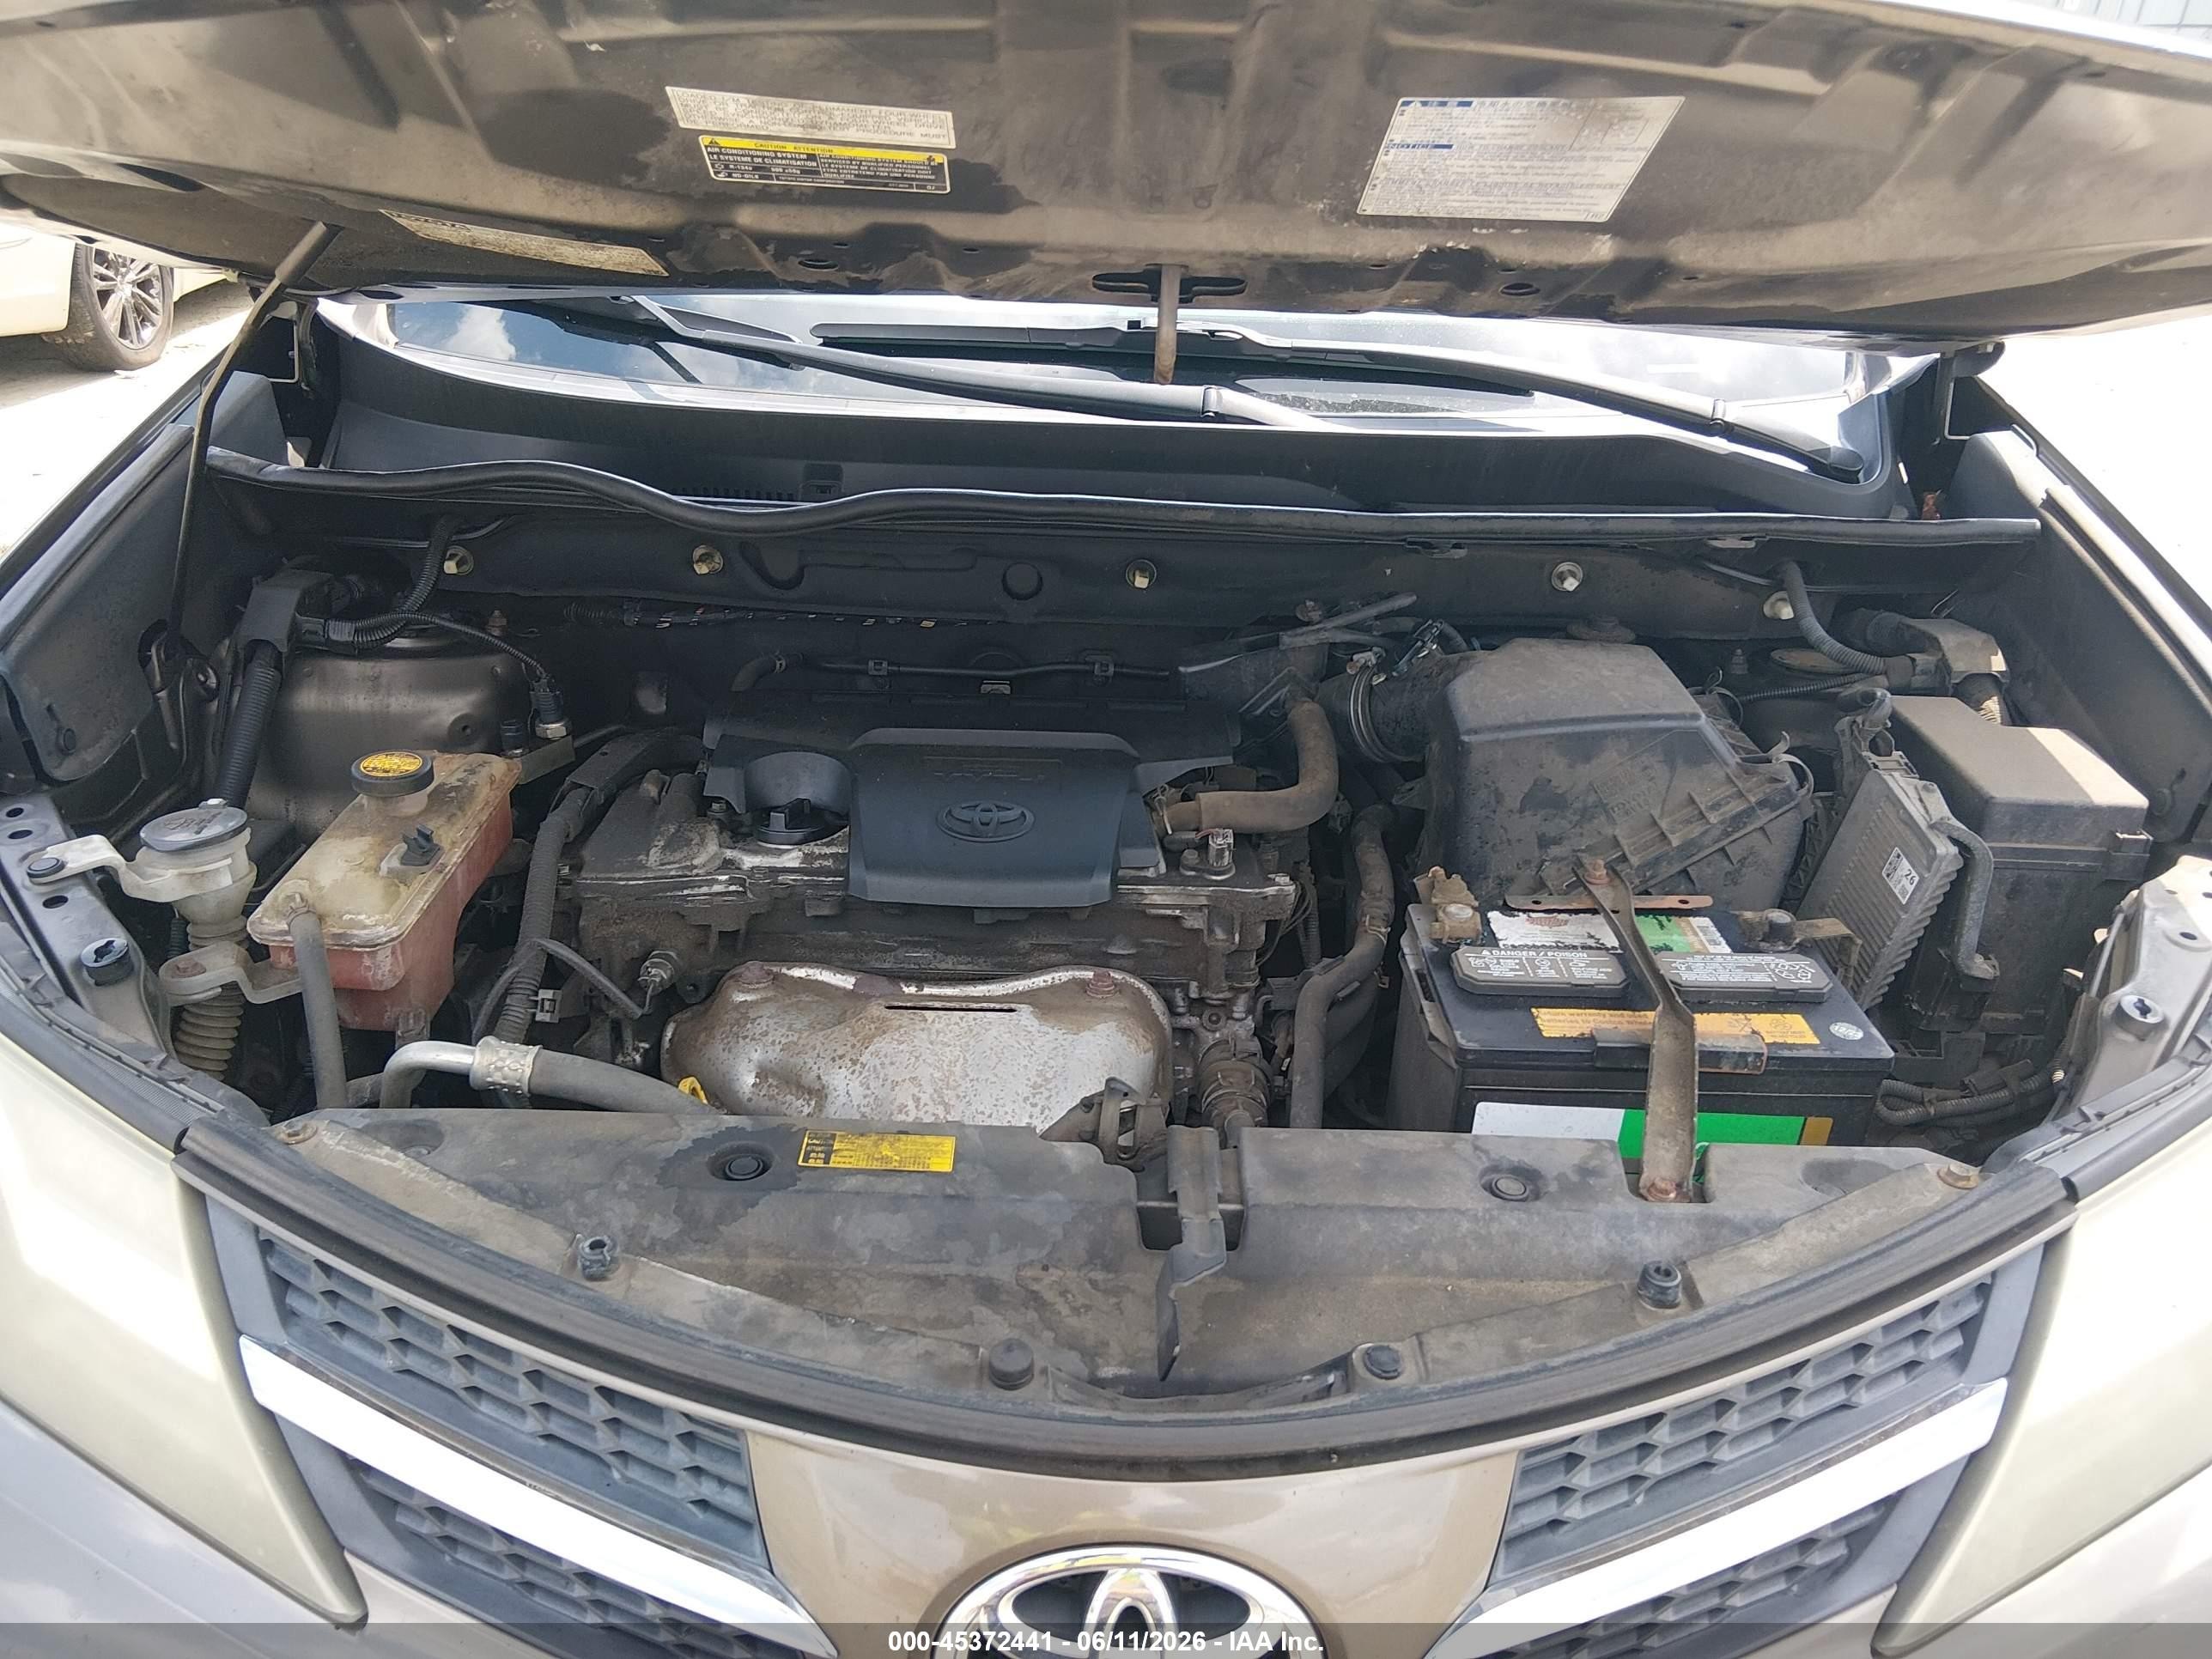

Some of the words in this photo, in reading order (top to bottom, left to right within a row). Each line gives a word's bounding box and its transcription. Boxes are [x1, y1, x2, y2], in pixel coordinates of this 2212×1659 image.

[721, 148, 775, 157] CONDITIONING
[764, 157, 817, 167] CLIMATISATION
[1904, 868, 1917, 885] 26
